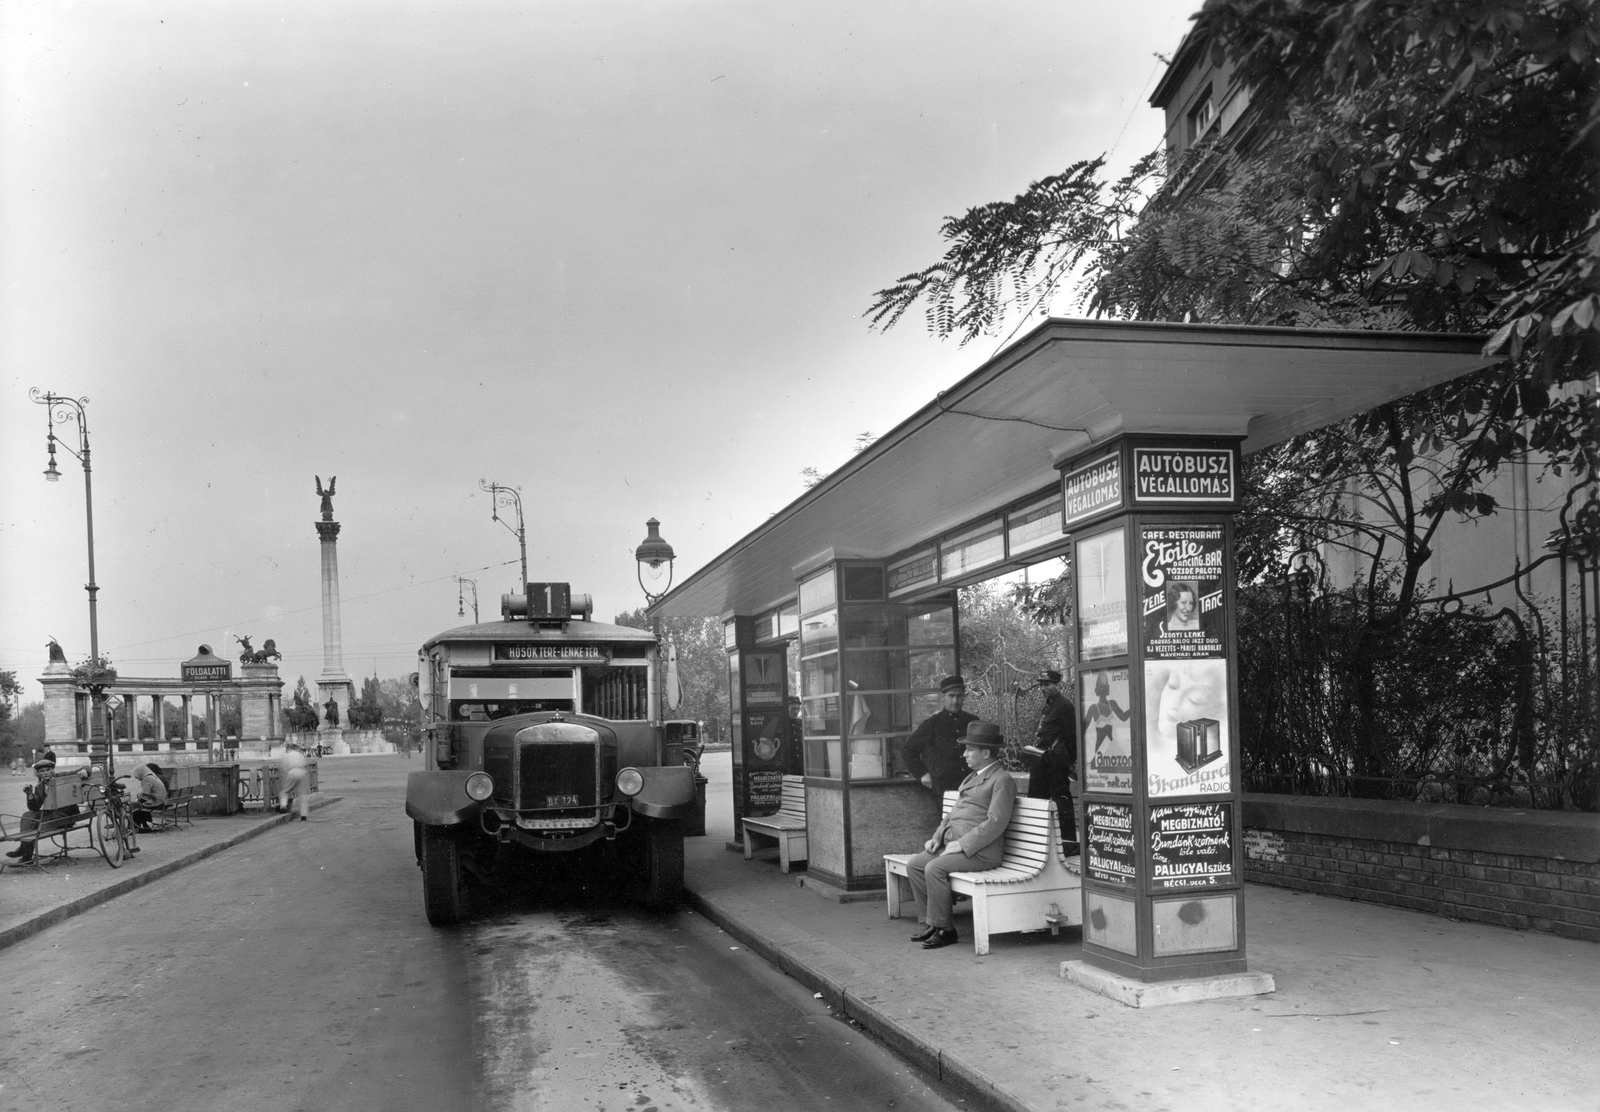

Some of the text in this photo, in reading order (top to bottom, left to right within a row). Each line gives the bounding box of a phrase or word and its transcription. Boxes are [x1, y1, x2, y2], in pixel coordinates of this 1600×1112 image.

[1139, 452, 1228, 474] AUTÓBUSZ
[1068, 460, 1118, 497] AUTÓBUSZ
[1140, 474, 1229, 493] VÉGÁLLOMÁS
[1068, 482, 1119, 515] VÉGÁLLOMÁS
[1142, 531, 1221, 539] CAFE-RESTAURANT
[1142, 540, 1203, 587] Etoile
[544, 586, 552, 614] 1
[1143, 590, 1166, 616] ZENE
[1200, 782, 1230, 792] RADIO
[1093, 813, 1132, 829] MEGBIZHATÓ!
[1161, 811, 1225, 831] MEGBIZHATÓ!
[1089, 855, 1121, 871] PALUGYAI
[1155, 862, 1208, 876] PALUGYAI
